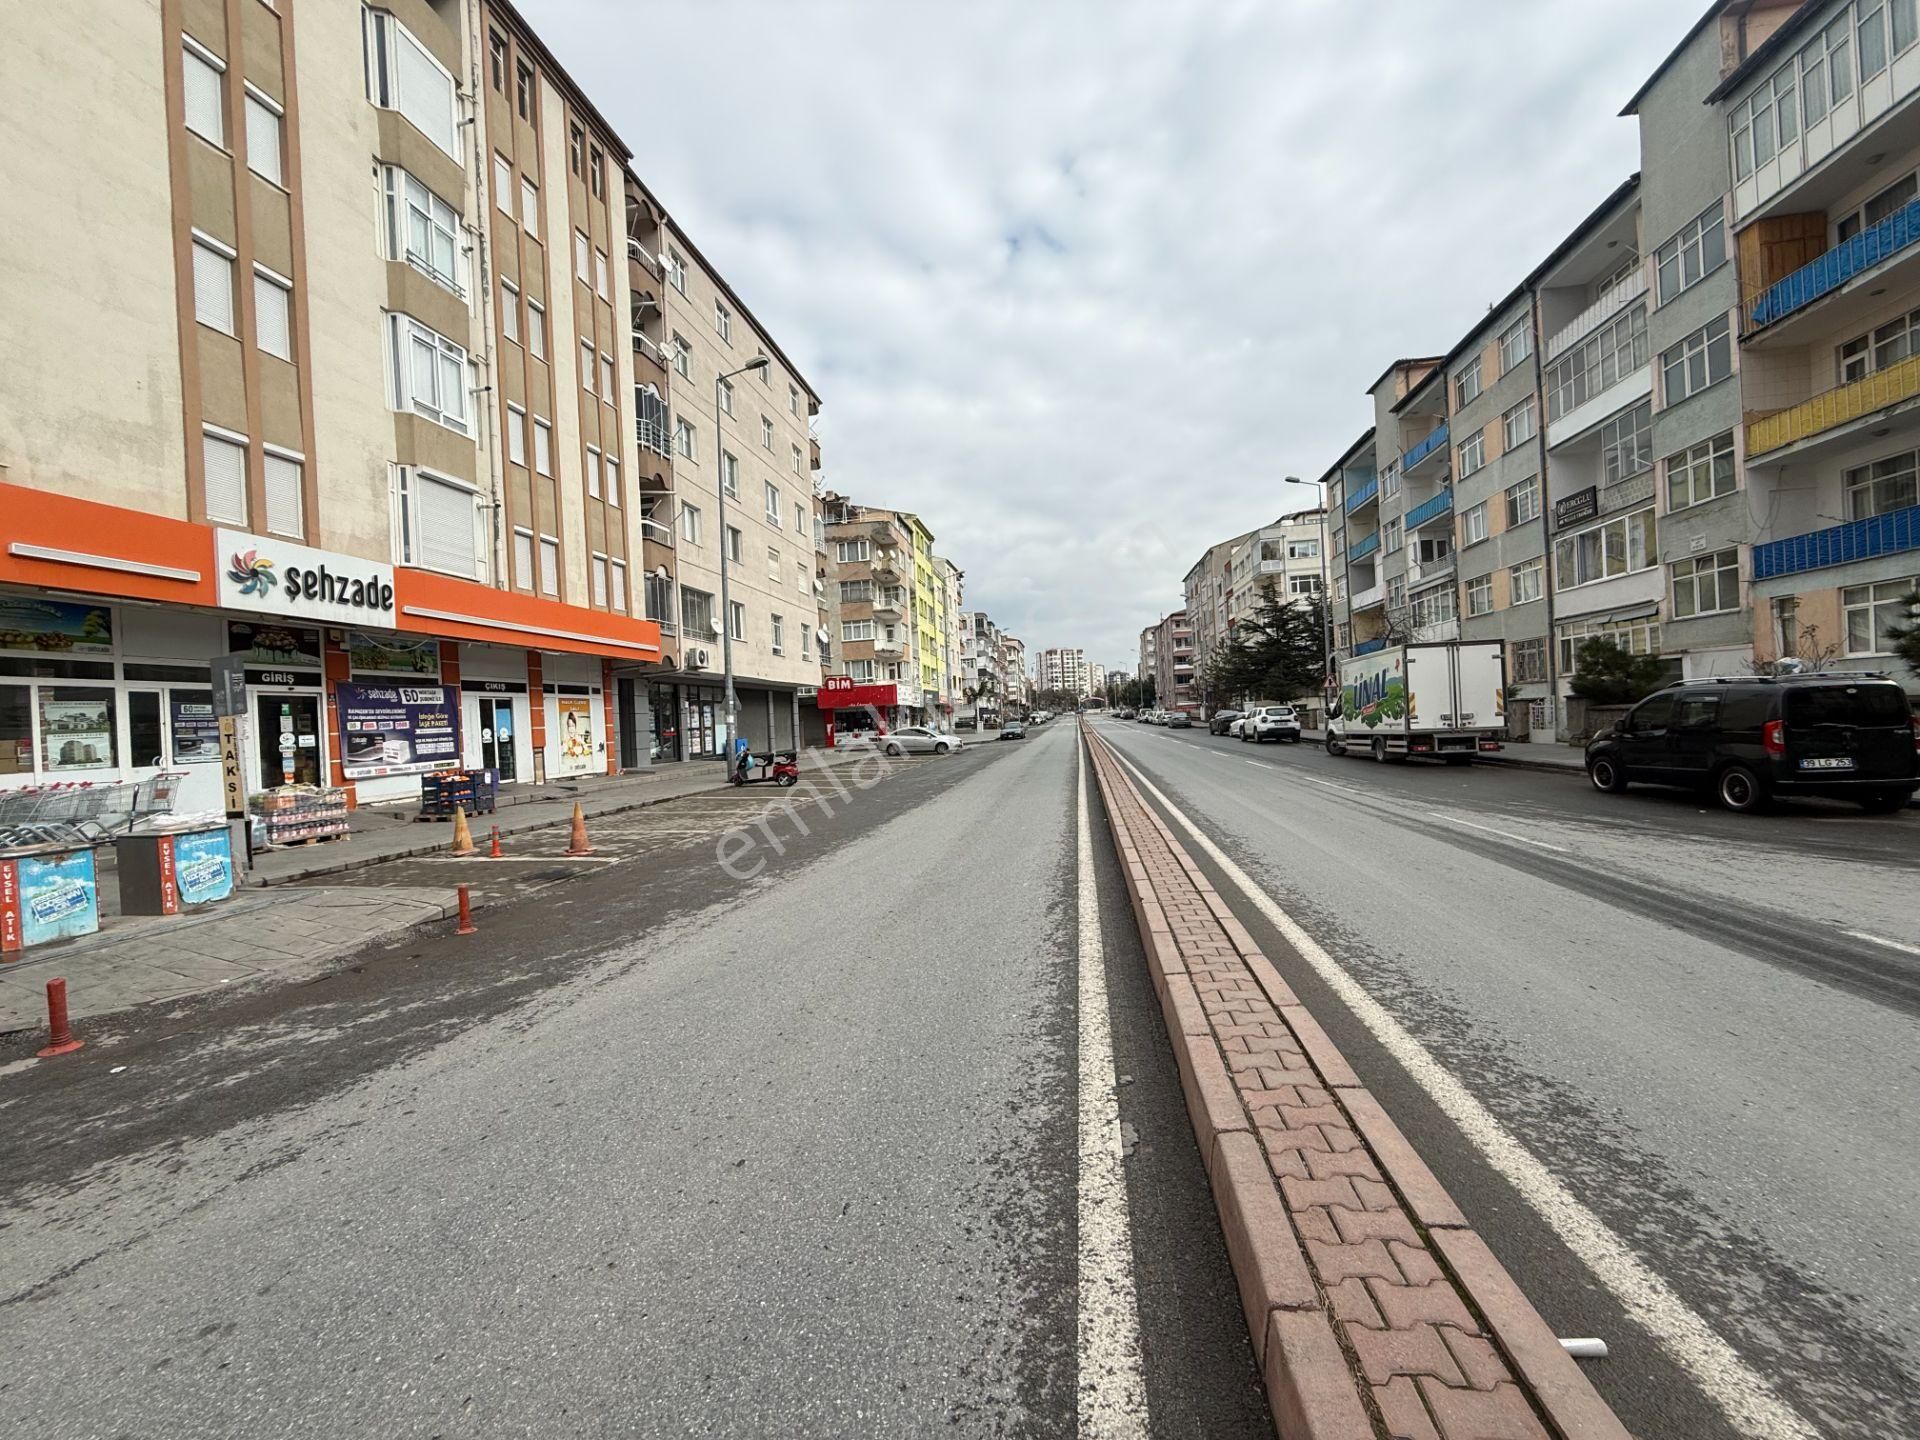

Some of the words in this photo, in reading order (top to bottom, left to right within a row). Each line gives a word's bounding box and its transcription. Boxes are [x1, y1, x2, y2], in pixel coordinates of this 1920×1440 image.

[284, 564, 394, 612] şehzade
[261, 671, 295, 684] GİRİŞ
[485, 682, 506, 691] ÇIKIŞ
[827, 677, 852, 690] BİM
[1353, 667, 1389, 710] ÜNAL
[403, 689, 419, 702] 60
[224, 733, 237, 809] TAKSİ
[163, 842, 172, 875] EVSEL
[3, 865, 13, 903] EVSEL
[164, 882, 174, 908] ATIK
[5, 911, 16, 941] ATIK
